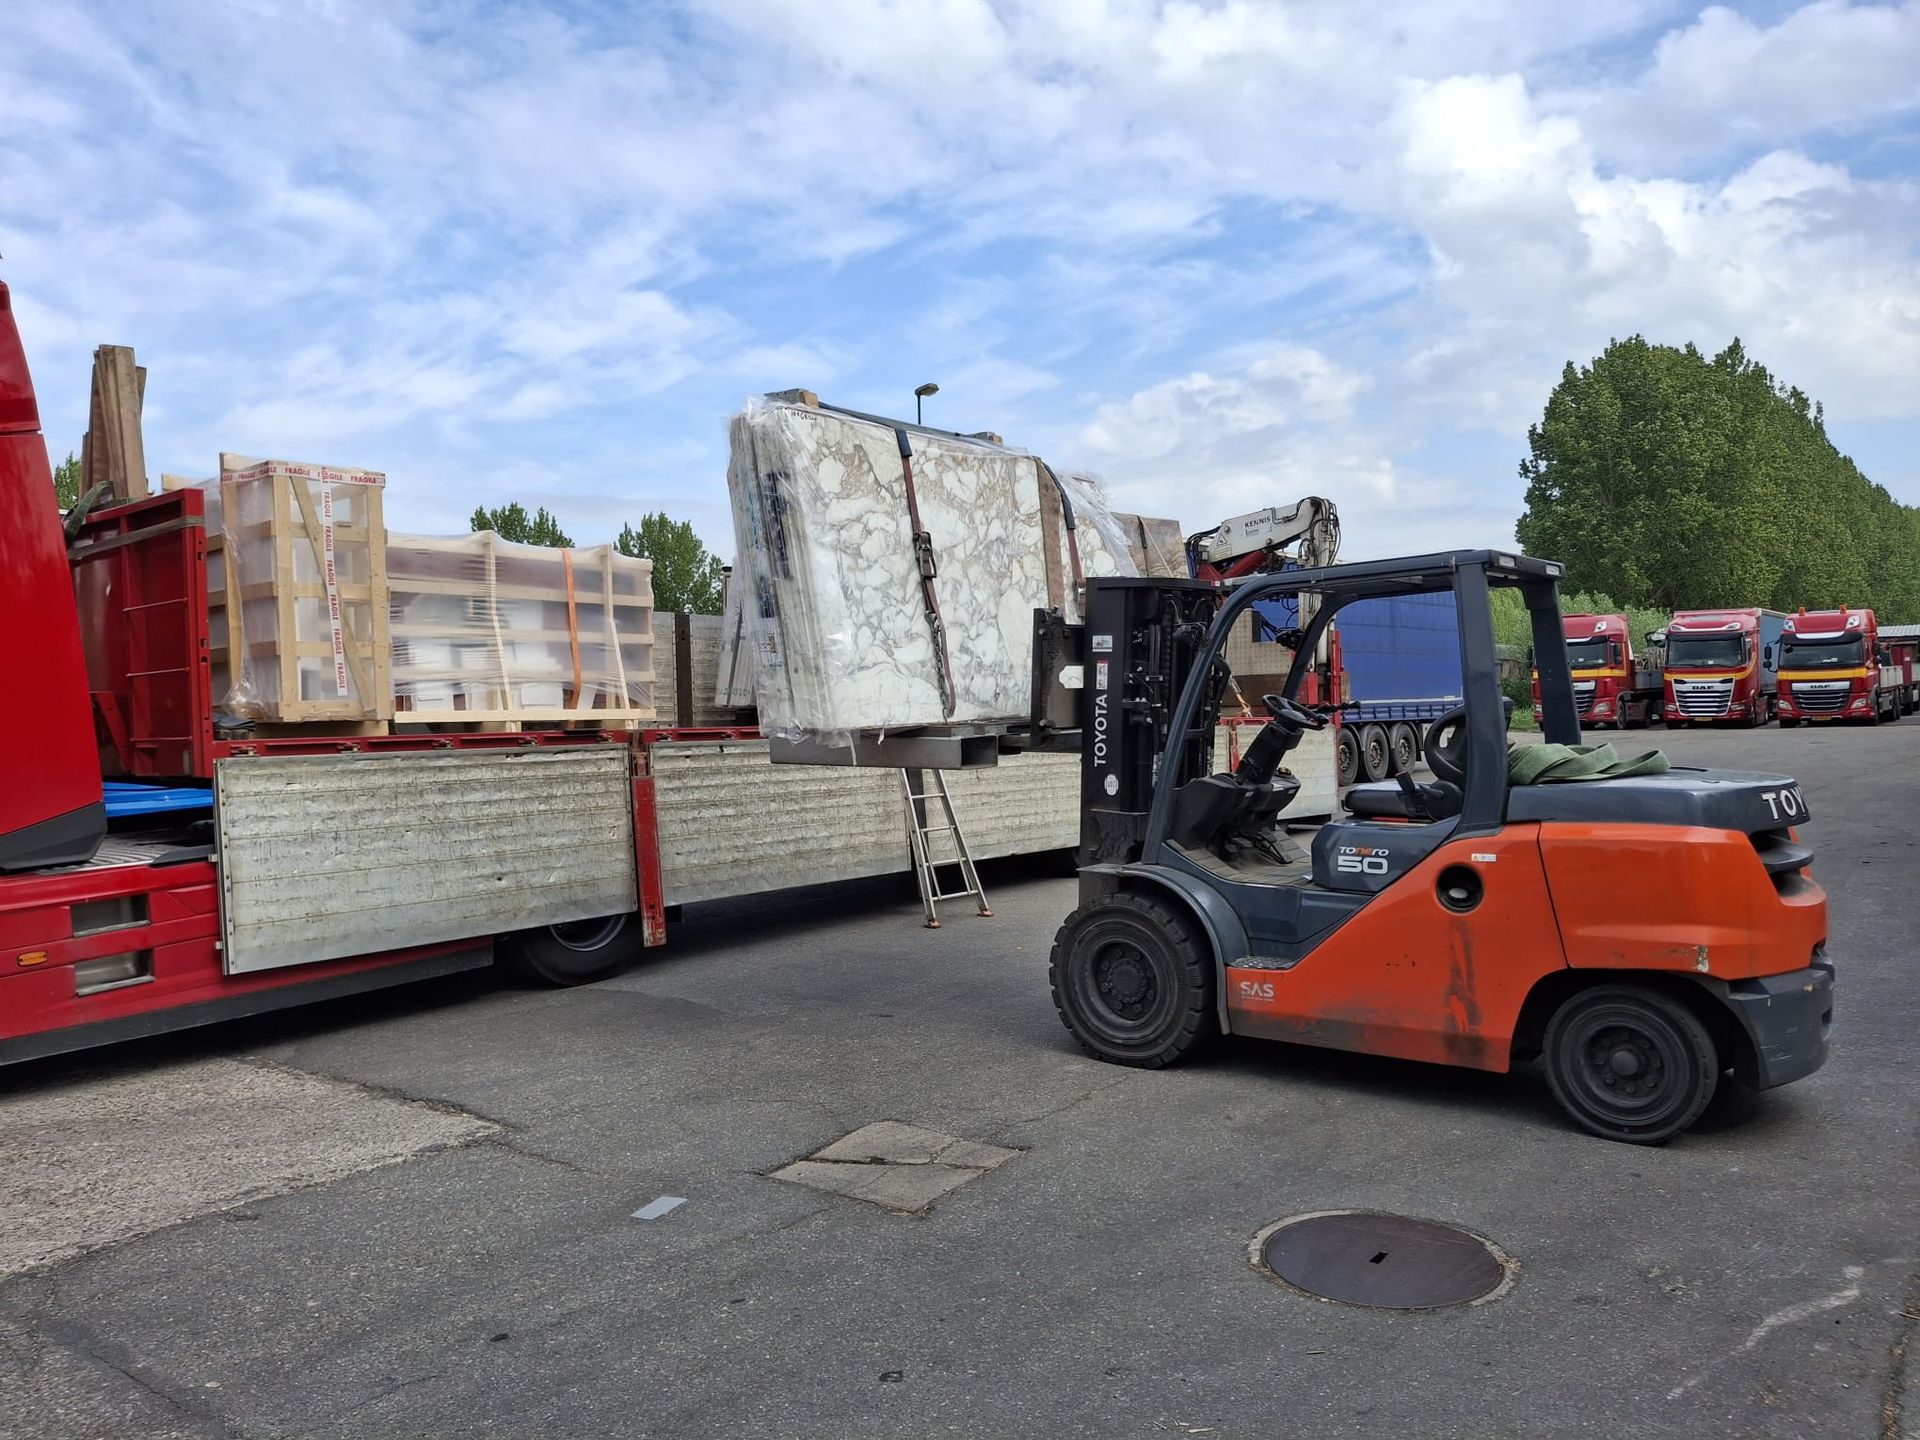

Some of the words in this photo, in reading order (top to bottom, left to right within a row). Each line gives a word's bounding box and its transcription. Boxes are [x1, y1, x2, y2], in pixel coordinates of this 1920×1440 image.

[285, 466, 310, 476] FRAGILE
[351, 475, 376, 484] FRAGILE
[323, 491, 331, 517] FRAGILE
[1244, 516, 1271, 527] KENNIS
[327, 560, 336, 586] FRAGILE
[330, 594, 339, 620] FRAGILE
[334, 628, 342, 655] FRAGILE
[336, 662, 346, 689] FRAGILE
[1094, 694, 1108, 768] TOYOTA
[1337, 855, 1388, 875] 50
[1240, 981, 1274, 998] SAS
